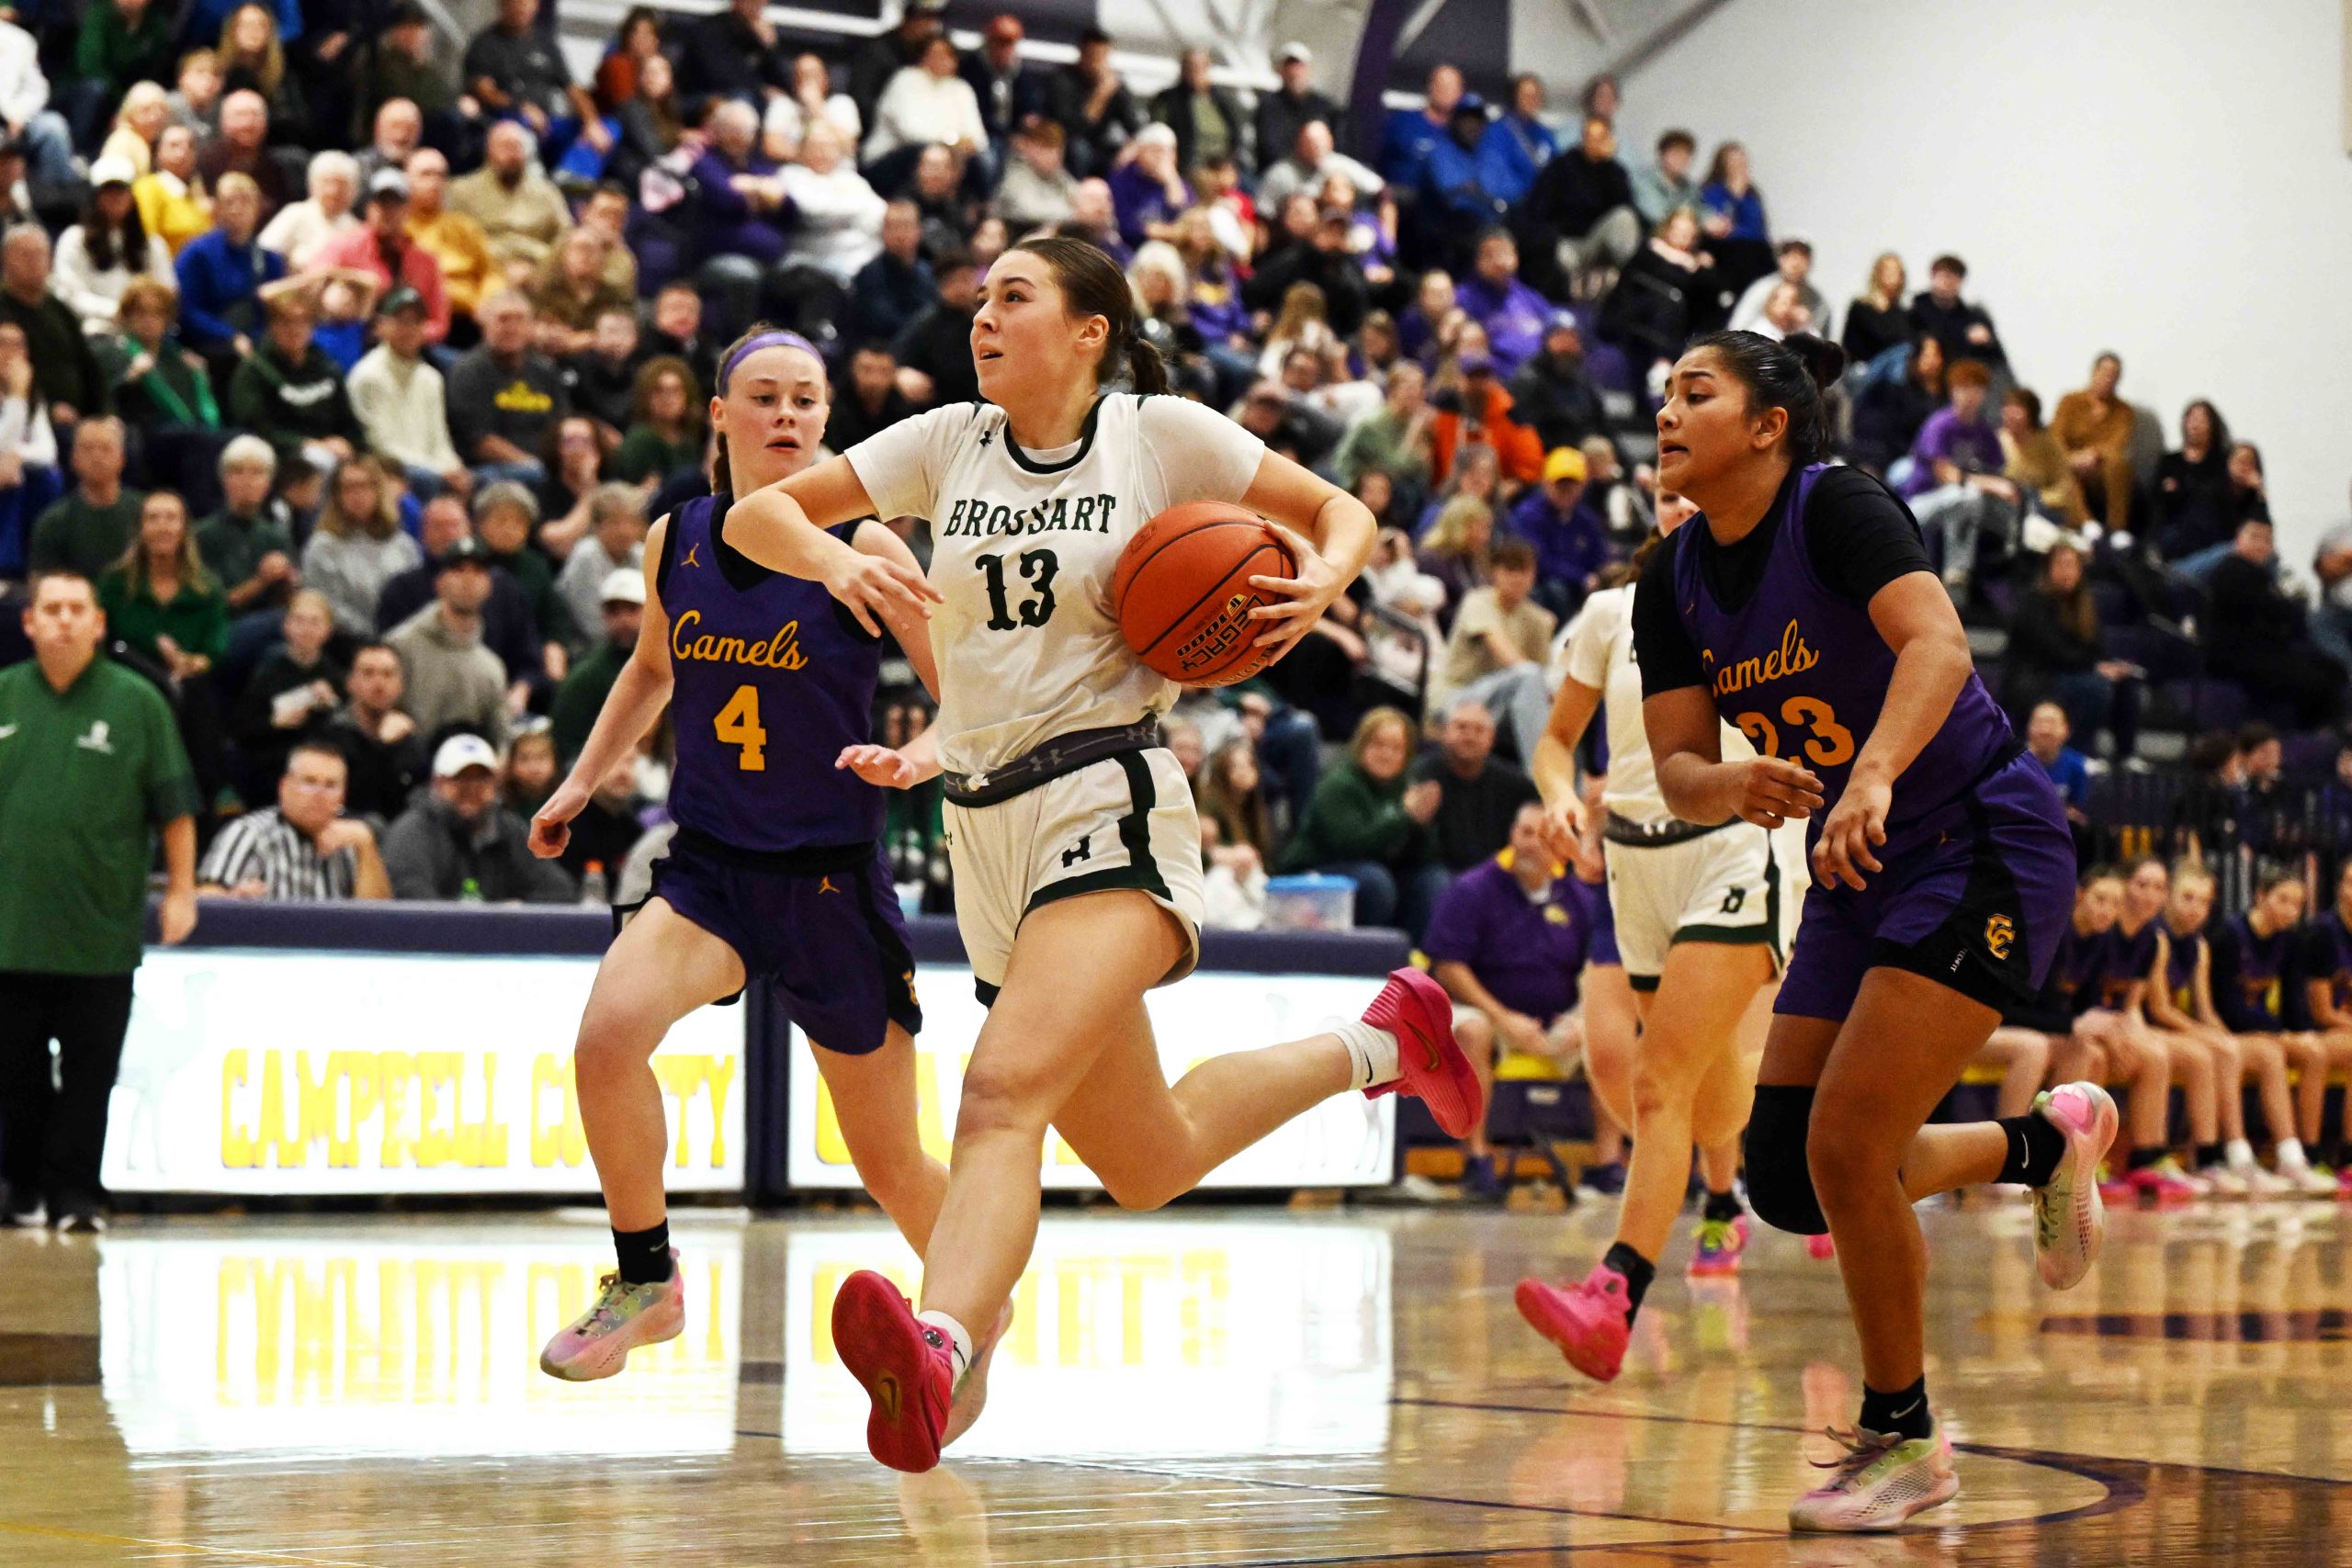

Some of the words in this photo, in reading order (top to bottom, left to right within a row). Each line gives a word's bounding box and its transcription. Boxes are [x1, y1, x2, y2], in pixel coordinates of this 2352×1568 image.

[944, 493, 1116, 537] BROSSART
[975, 548, 1060, 631] 13
[673, 610, 808, 671] Camels
[713, 684, 767, 771] 4
[530, 1053, 735, 1168] COTY
